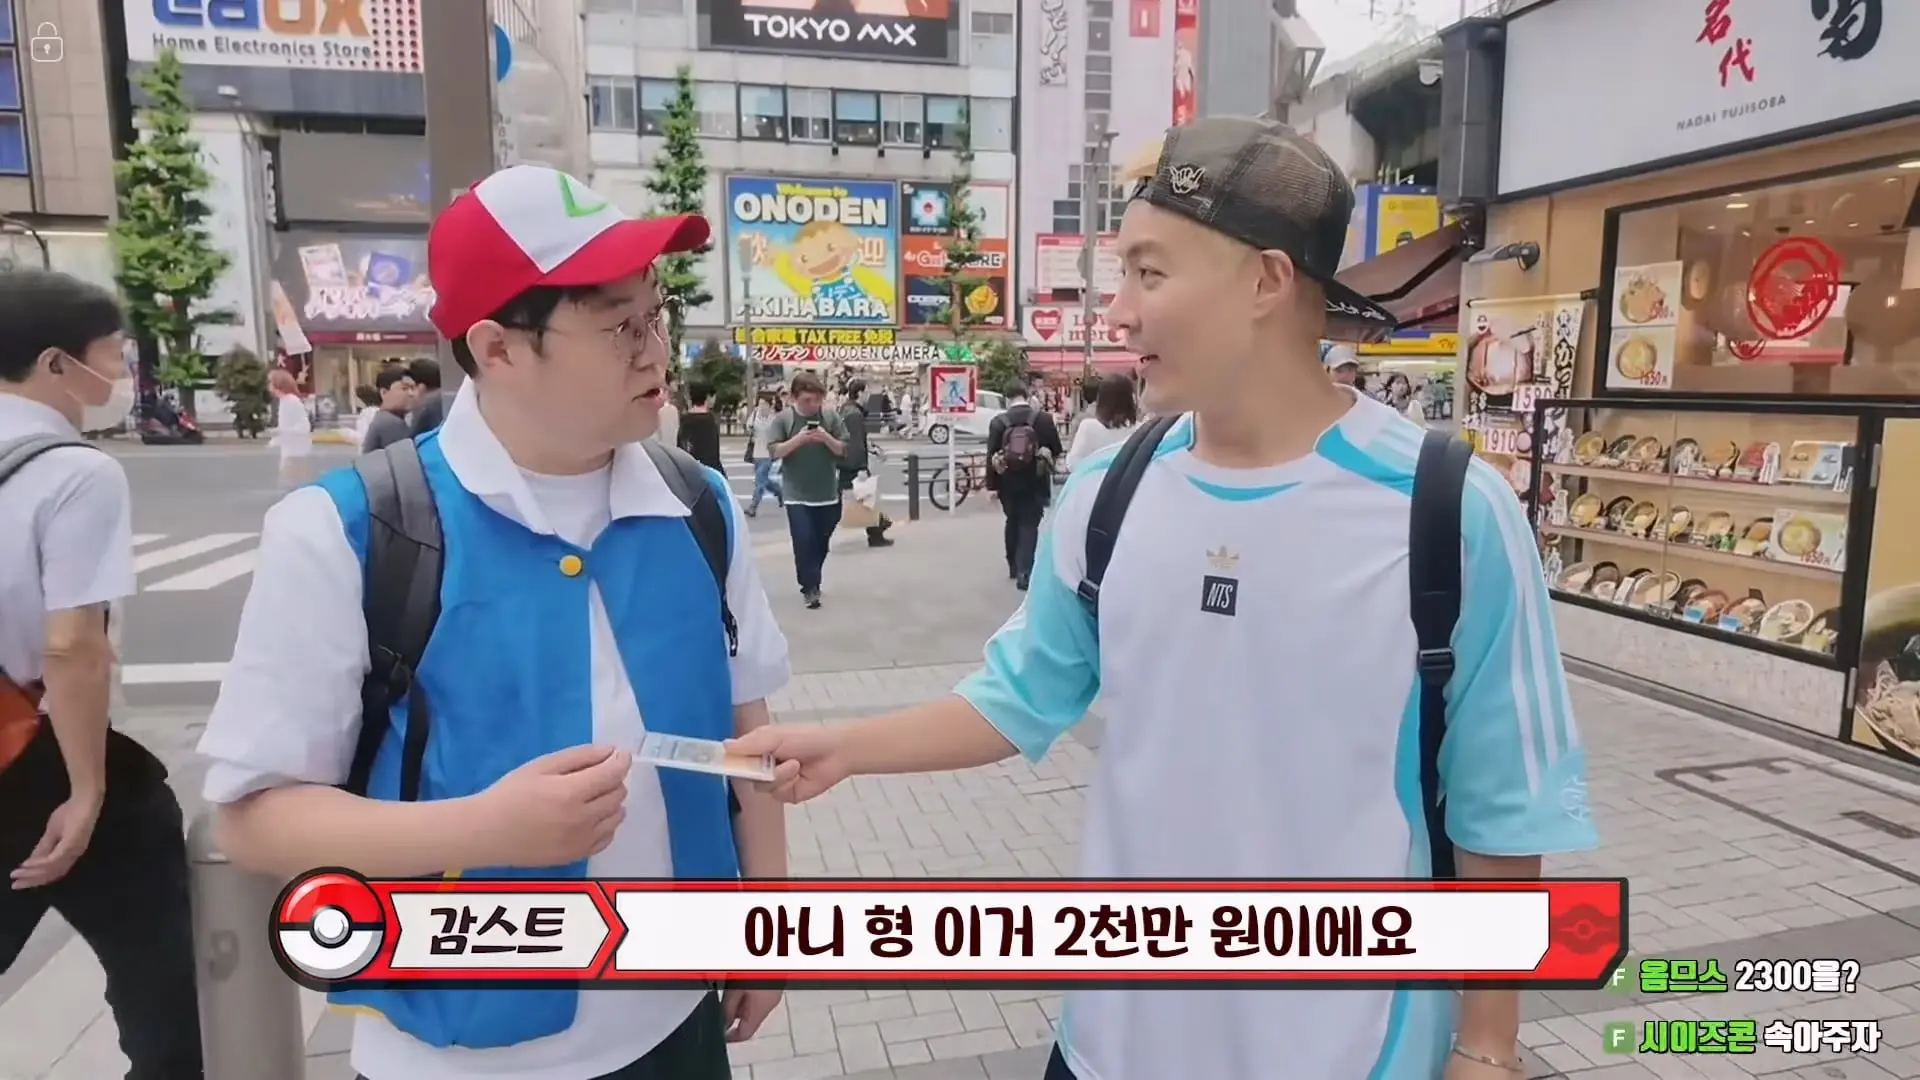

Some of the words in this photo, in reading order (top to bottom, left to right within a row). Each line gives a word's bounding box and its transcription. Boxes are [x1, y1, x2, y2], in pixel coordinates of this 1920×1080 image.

[743, 13, 850, 42] TOKYO
[857, 23, 917, 47] MX
[152, 32, 207, 52] Home
[214, 36, 316, 57] Electronics
[322, 41, 371, 59] Store
[1676, 113, 1716, 131] NADAI
[1721, 95, 1787, 120] FUJISOBA
[734, 192, 888, 227] ONODEN
[737, 297, 890, 319] AKIHABARA
[799, 329, 826, 344] TAX
[829, 330, 861, 344] FREE
[815, 345, 879, 361] ONODEN
[881, 346, 941, 361] CAMERA
[1206, 582, 1234, 609] NTS
